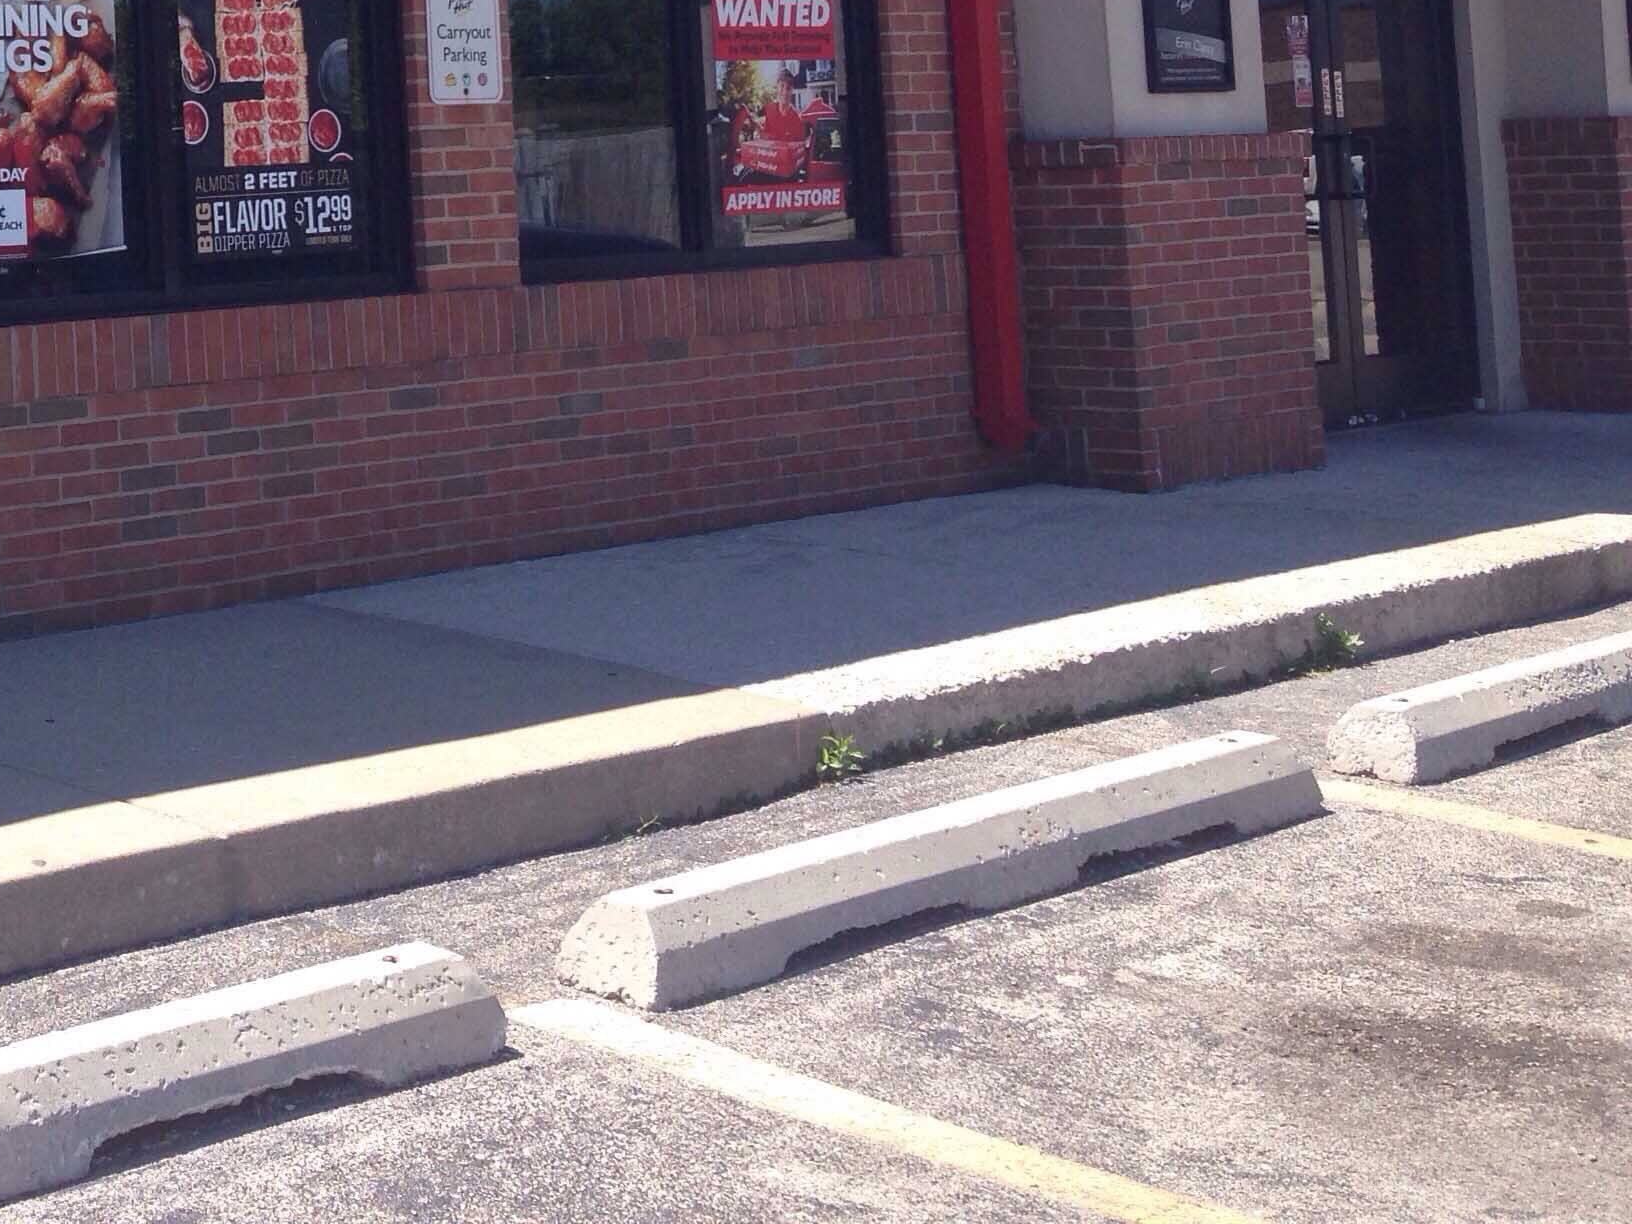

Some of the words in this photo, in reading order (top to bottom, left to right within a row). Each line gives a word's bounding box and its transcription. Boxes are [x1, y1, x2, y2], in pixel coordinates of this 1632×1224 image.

[453, 0, 474, 15] Hut
[436, 23, 491, 44] Carryout
[443, 47, 488, 66] Parking
[195, 175, 241, 193] ALMOST
[244, 175, 255, 190] 2
[259, 171, 298, 189] FEET
[301, 171, 313, 187] OF
[317, 169, 350, 187] PIZZA
[726, 190, 776, 211] APPLY
[776, 190, 794, 209] IN
[795, 187, 841, 207] STORE
[0, 221, 23, 231] EACH
[213, 197, 287, 234] FLAVOR
[196, 202, 213, 254] BIG
[214, 233, 256, 252] DIPPER
[259, 232, 291, 249] PIZZA
